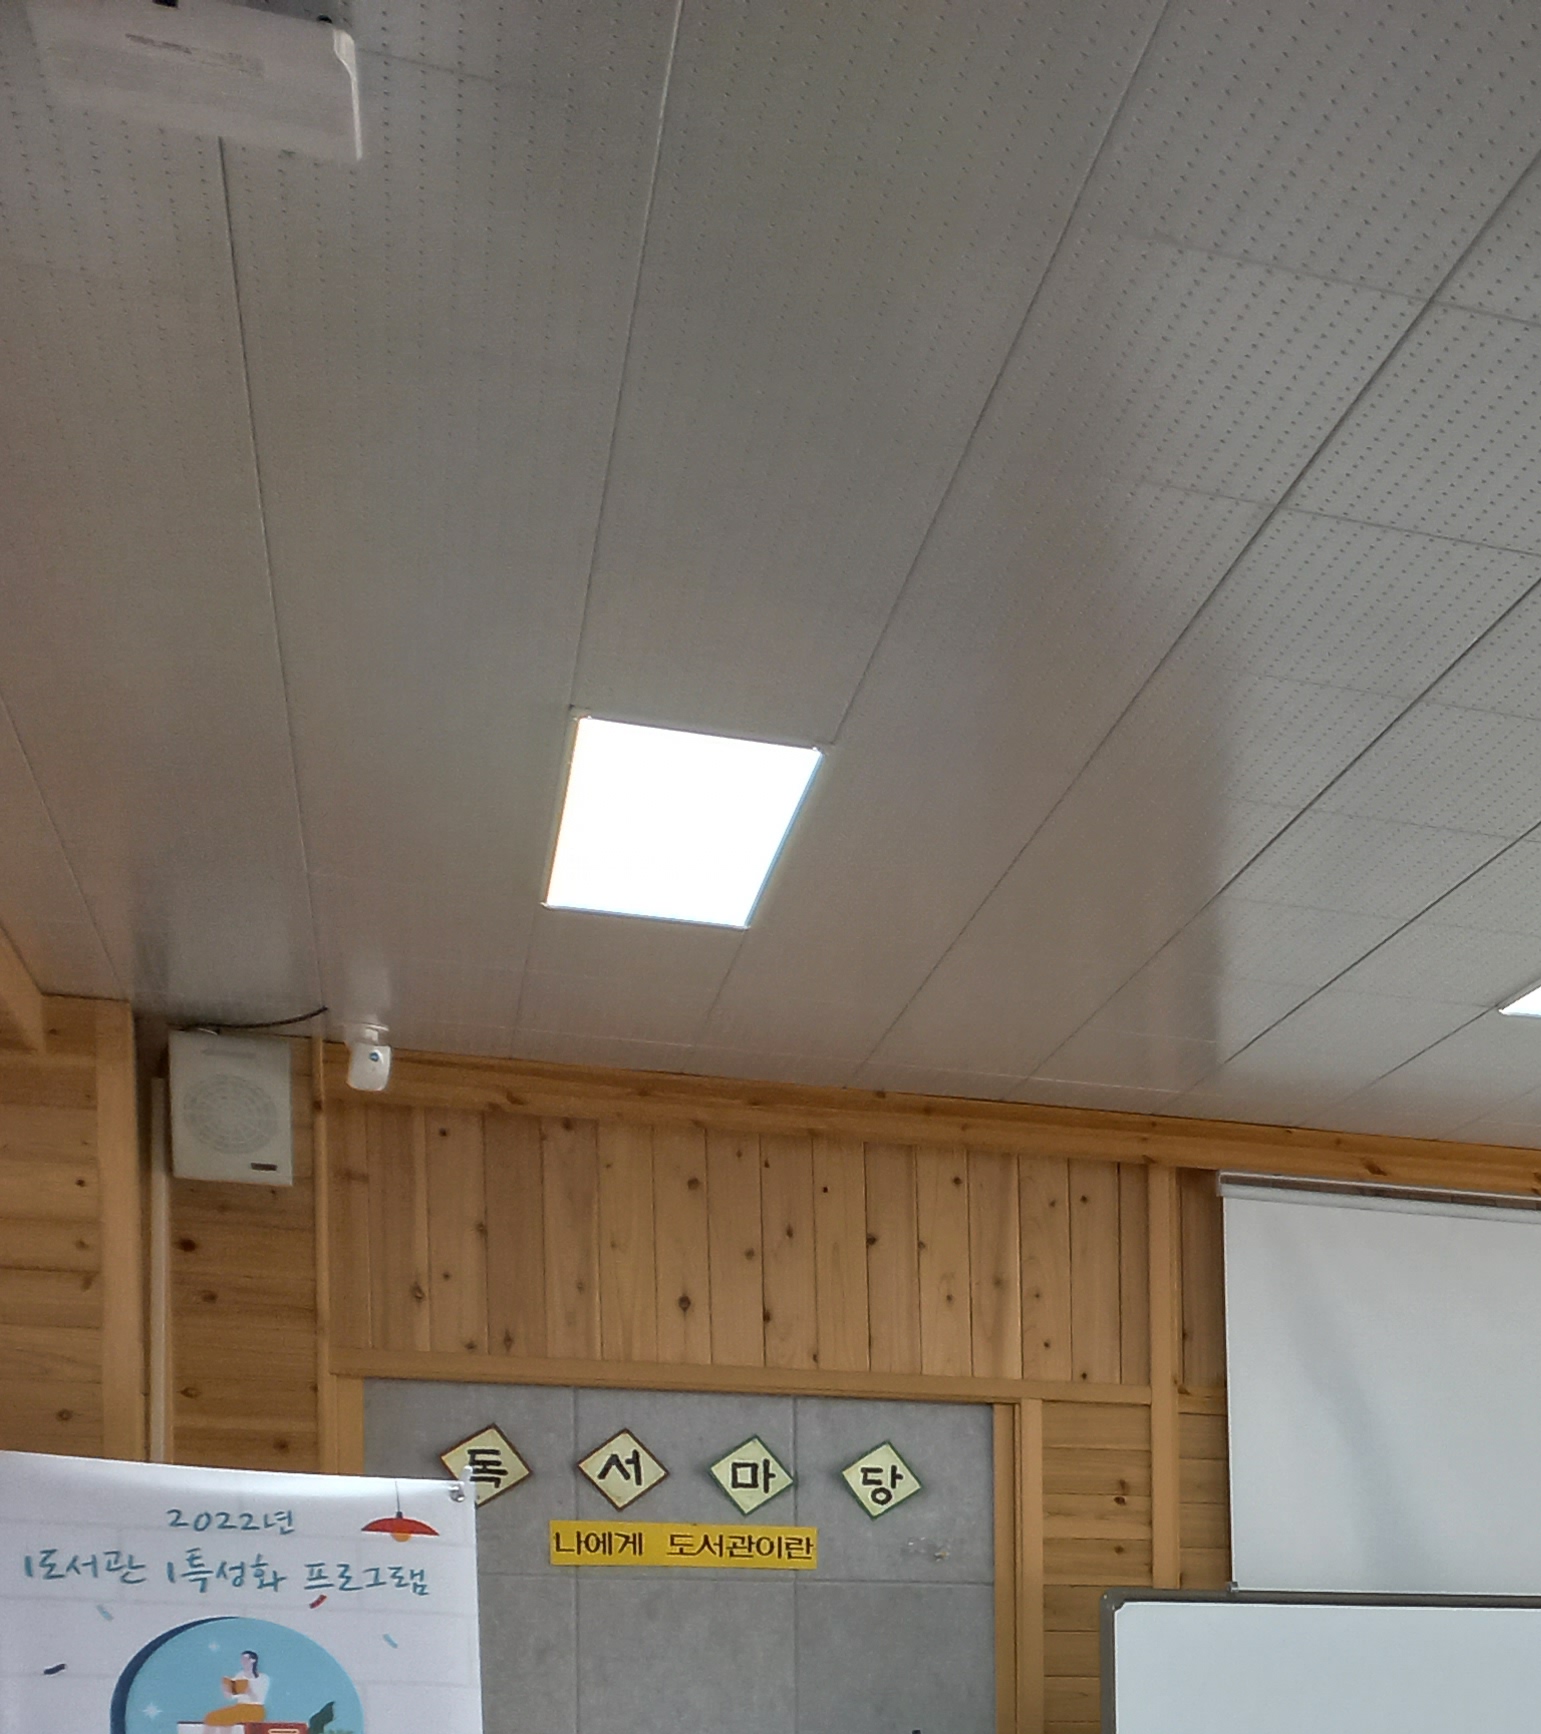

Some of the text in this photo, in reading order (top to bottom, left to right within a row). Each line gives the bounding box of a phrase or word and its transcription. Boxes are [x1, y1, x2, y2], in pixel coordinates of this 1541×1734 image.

[166, 1508, 295, 1536] 2022년
[553, 1530, 815, 1561] 나에게 도서관이란
[24, 1548, 429, 1596] 1도서관 1특성화 프로그램
